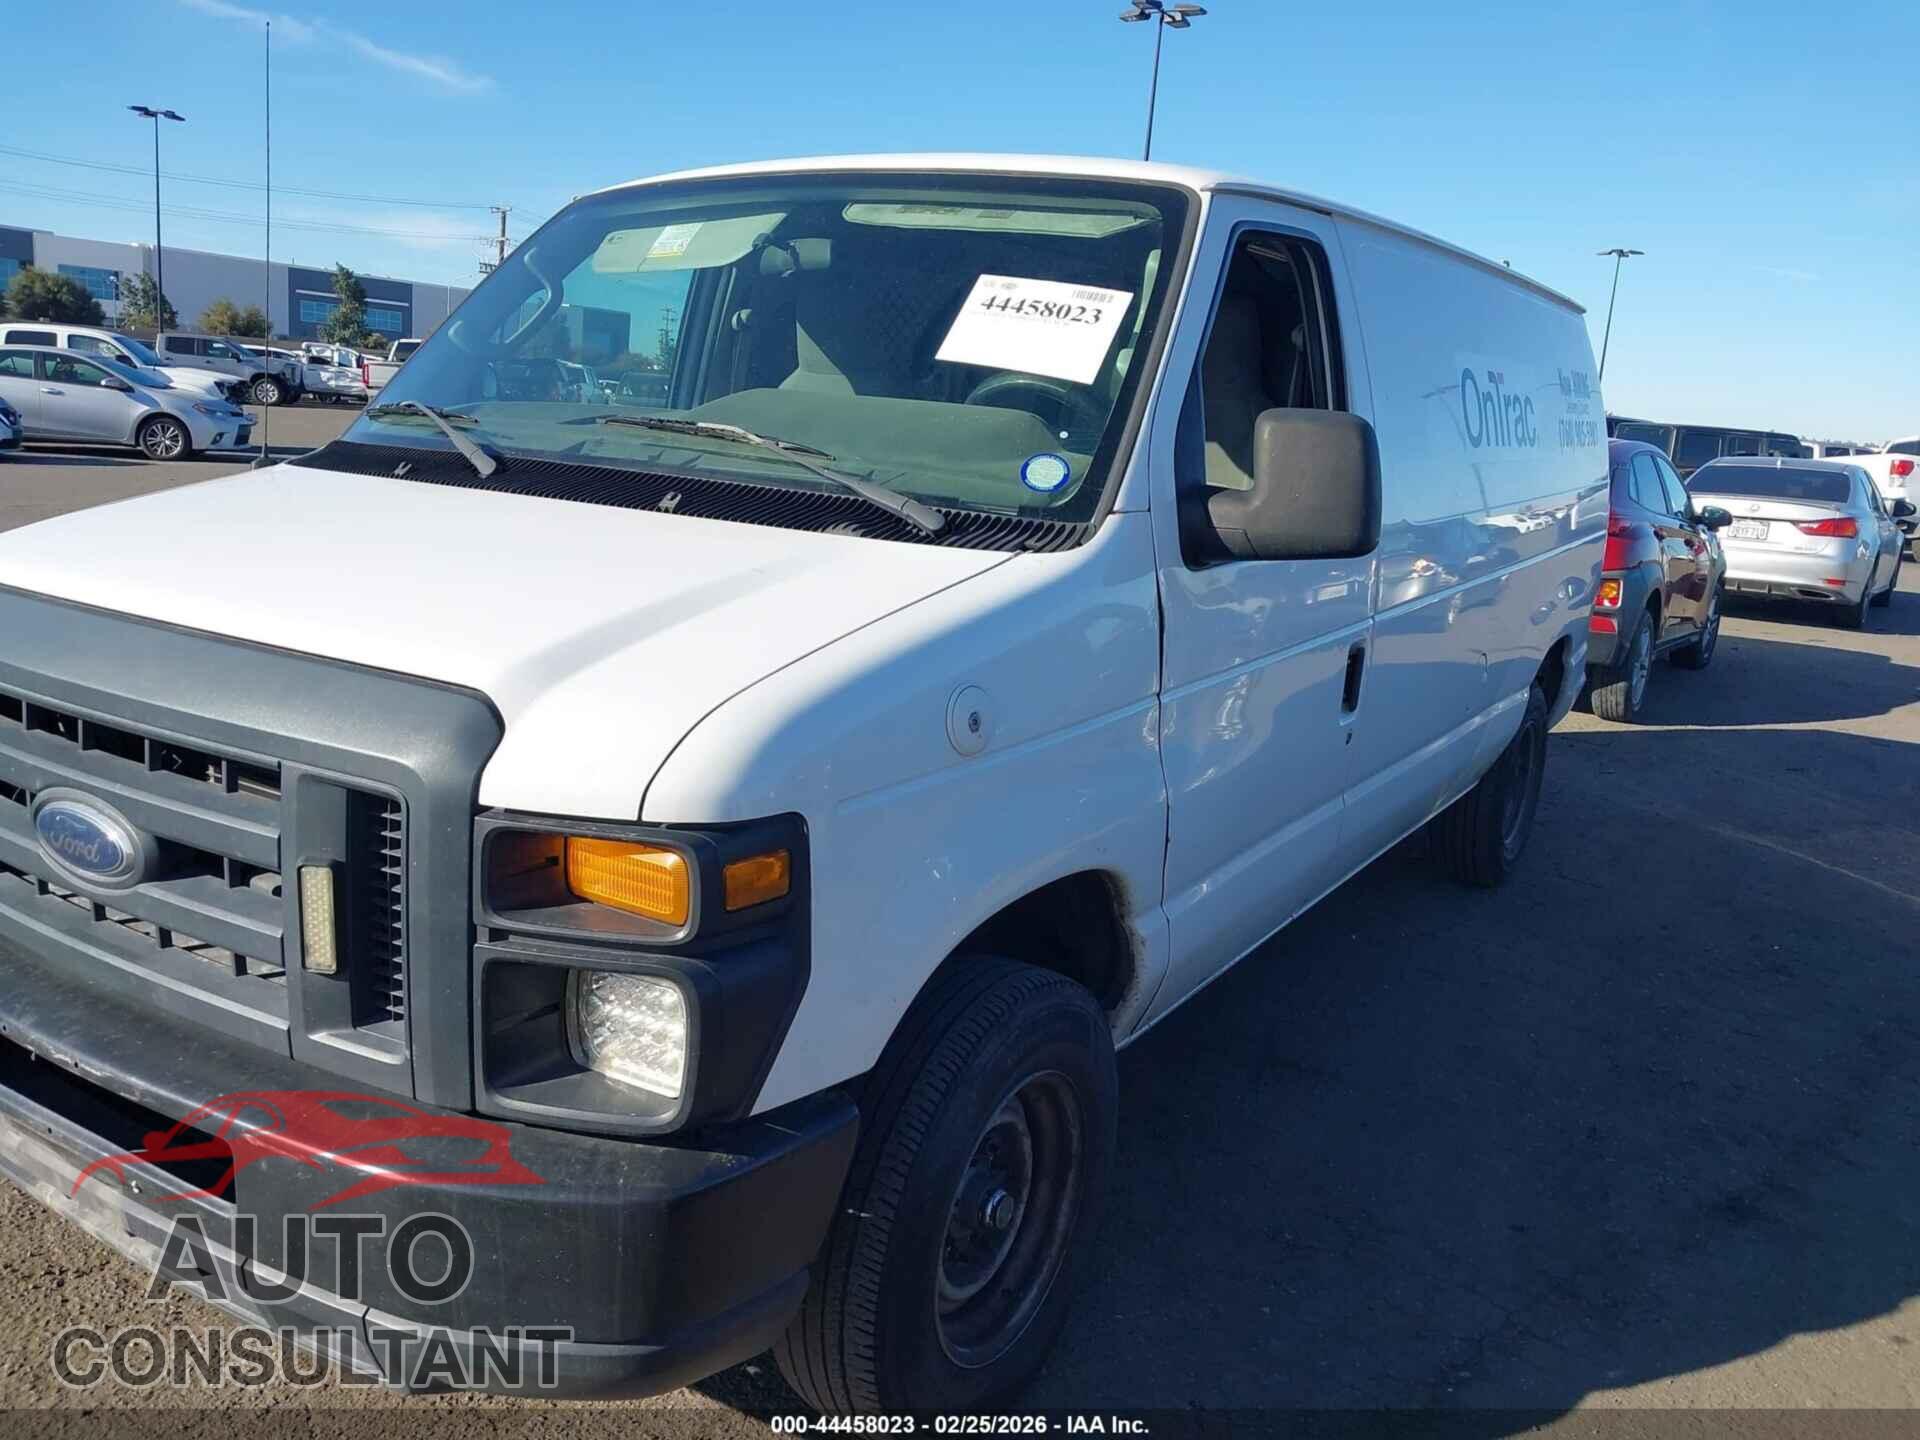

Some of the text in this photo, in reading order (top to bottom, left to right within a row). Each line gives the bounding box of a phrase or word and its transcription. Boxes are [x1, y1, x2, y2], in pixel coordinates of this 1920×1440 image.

[981, 294, 1102, 325] 44458023
[1461, 367, 1537, 449] OnTrac
[49, 830, 101, 863] Ford
